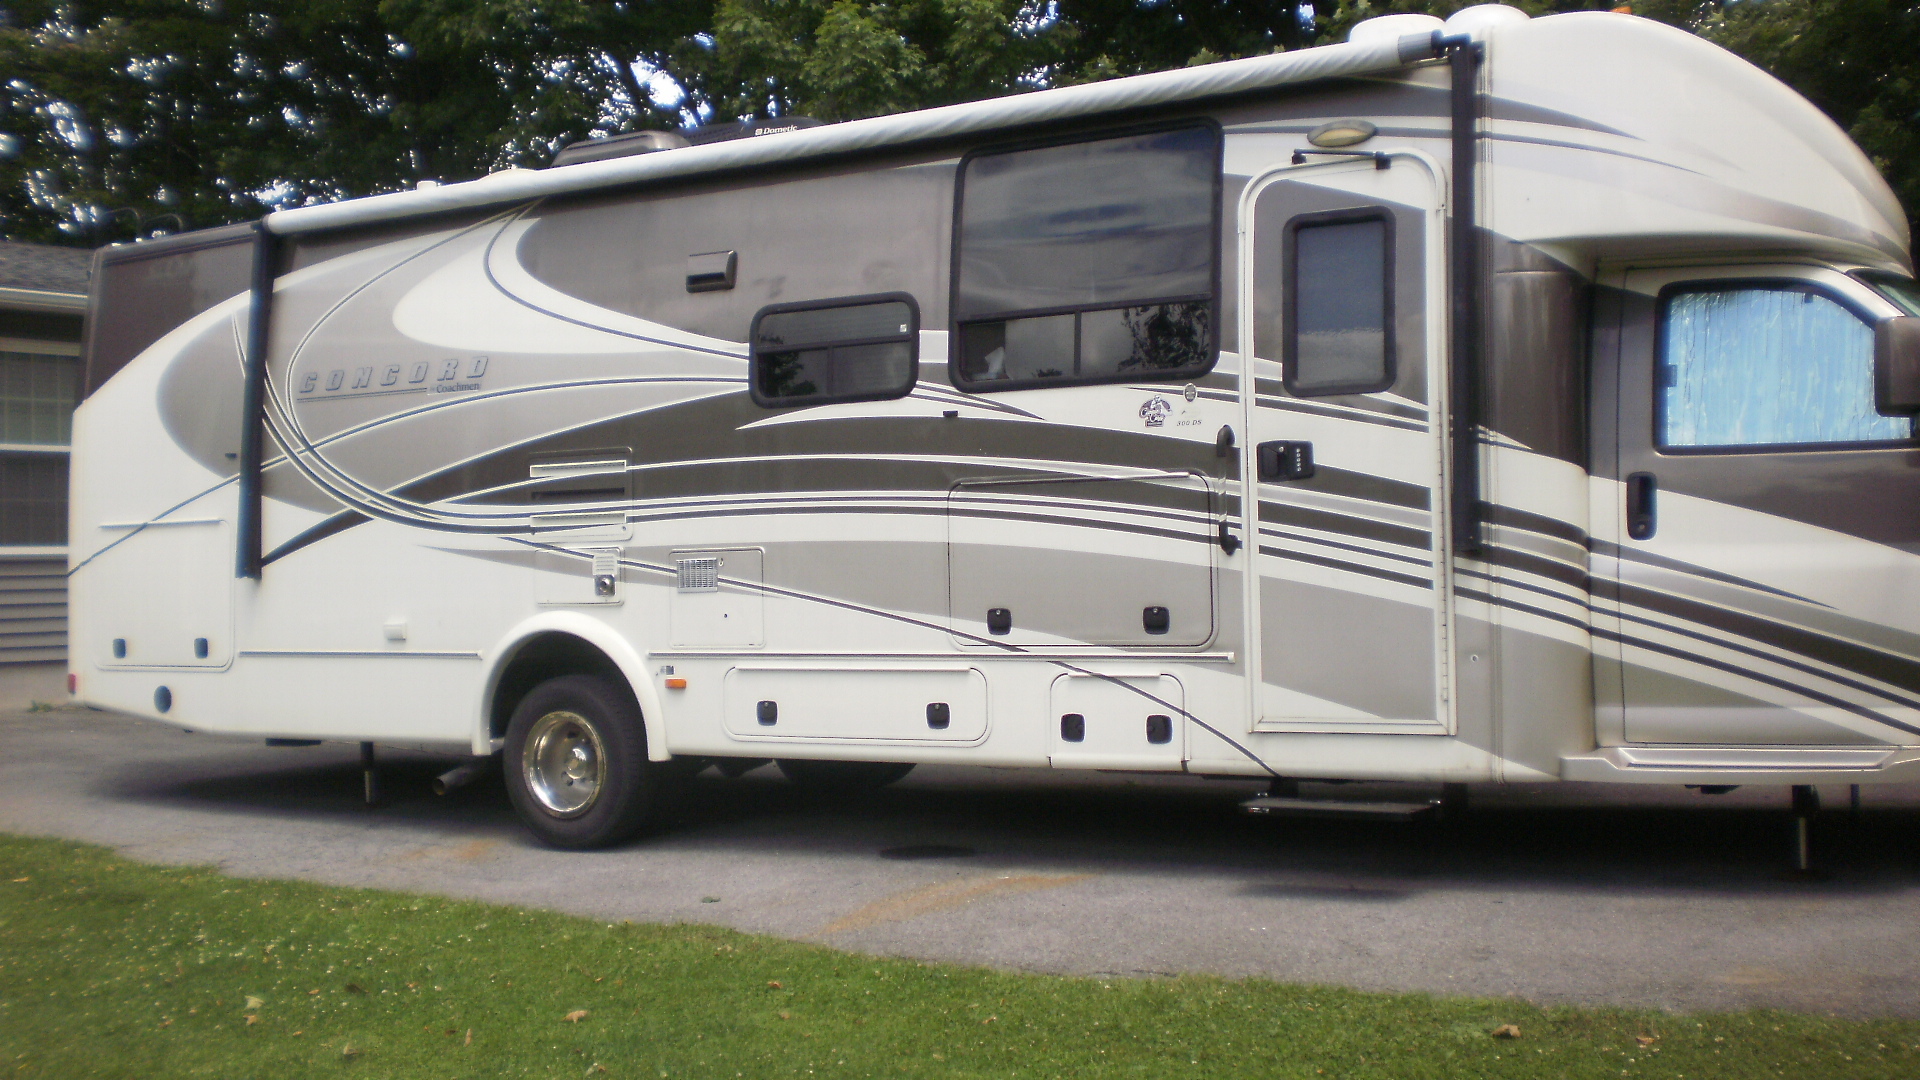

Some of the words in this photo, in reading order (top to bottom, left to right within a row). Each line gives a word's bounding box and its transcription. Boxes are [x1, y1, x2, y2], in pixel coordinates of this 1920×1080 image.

[763, 124, 798, 135] Dometic
[299, 355, 489, 394] CONCORD
[436, 382, 481, 394] Coachmen
